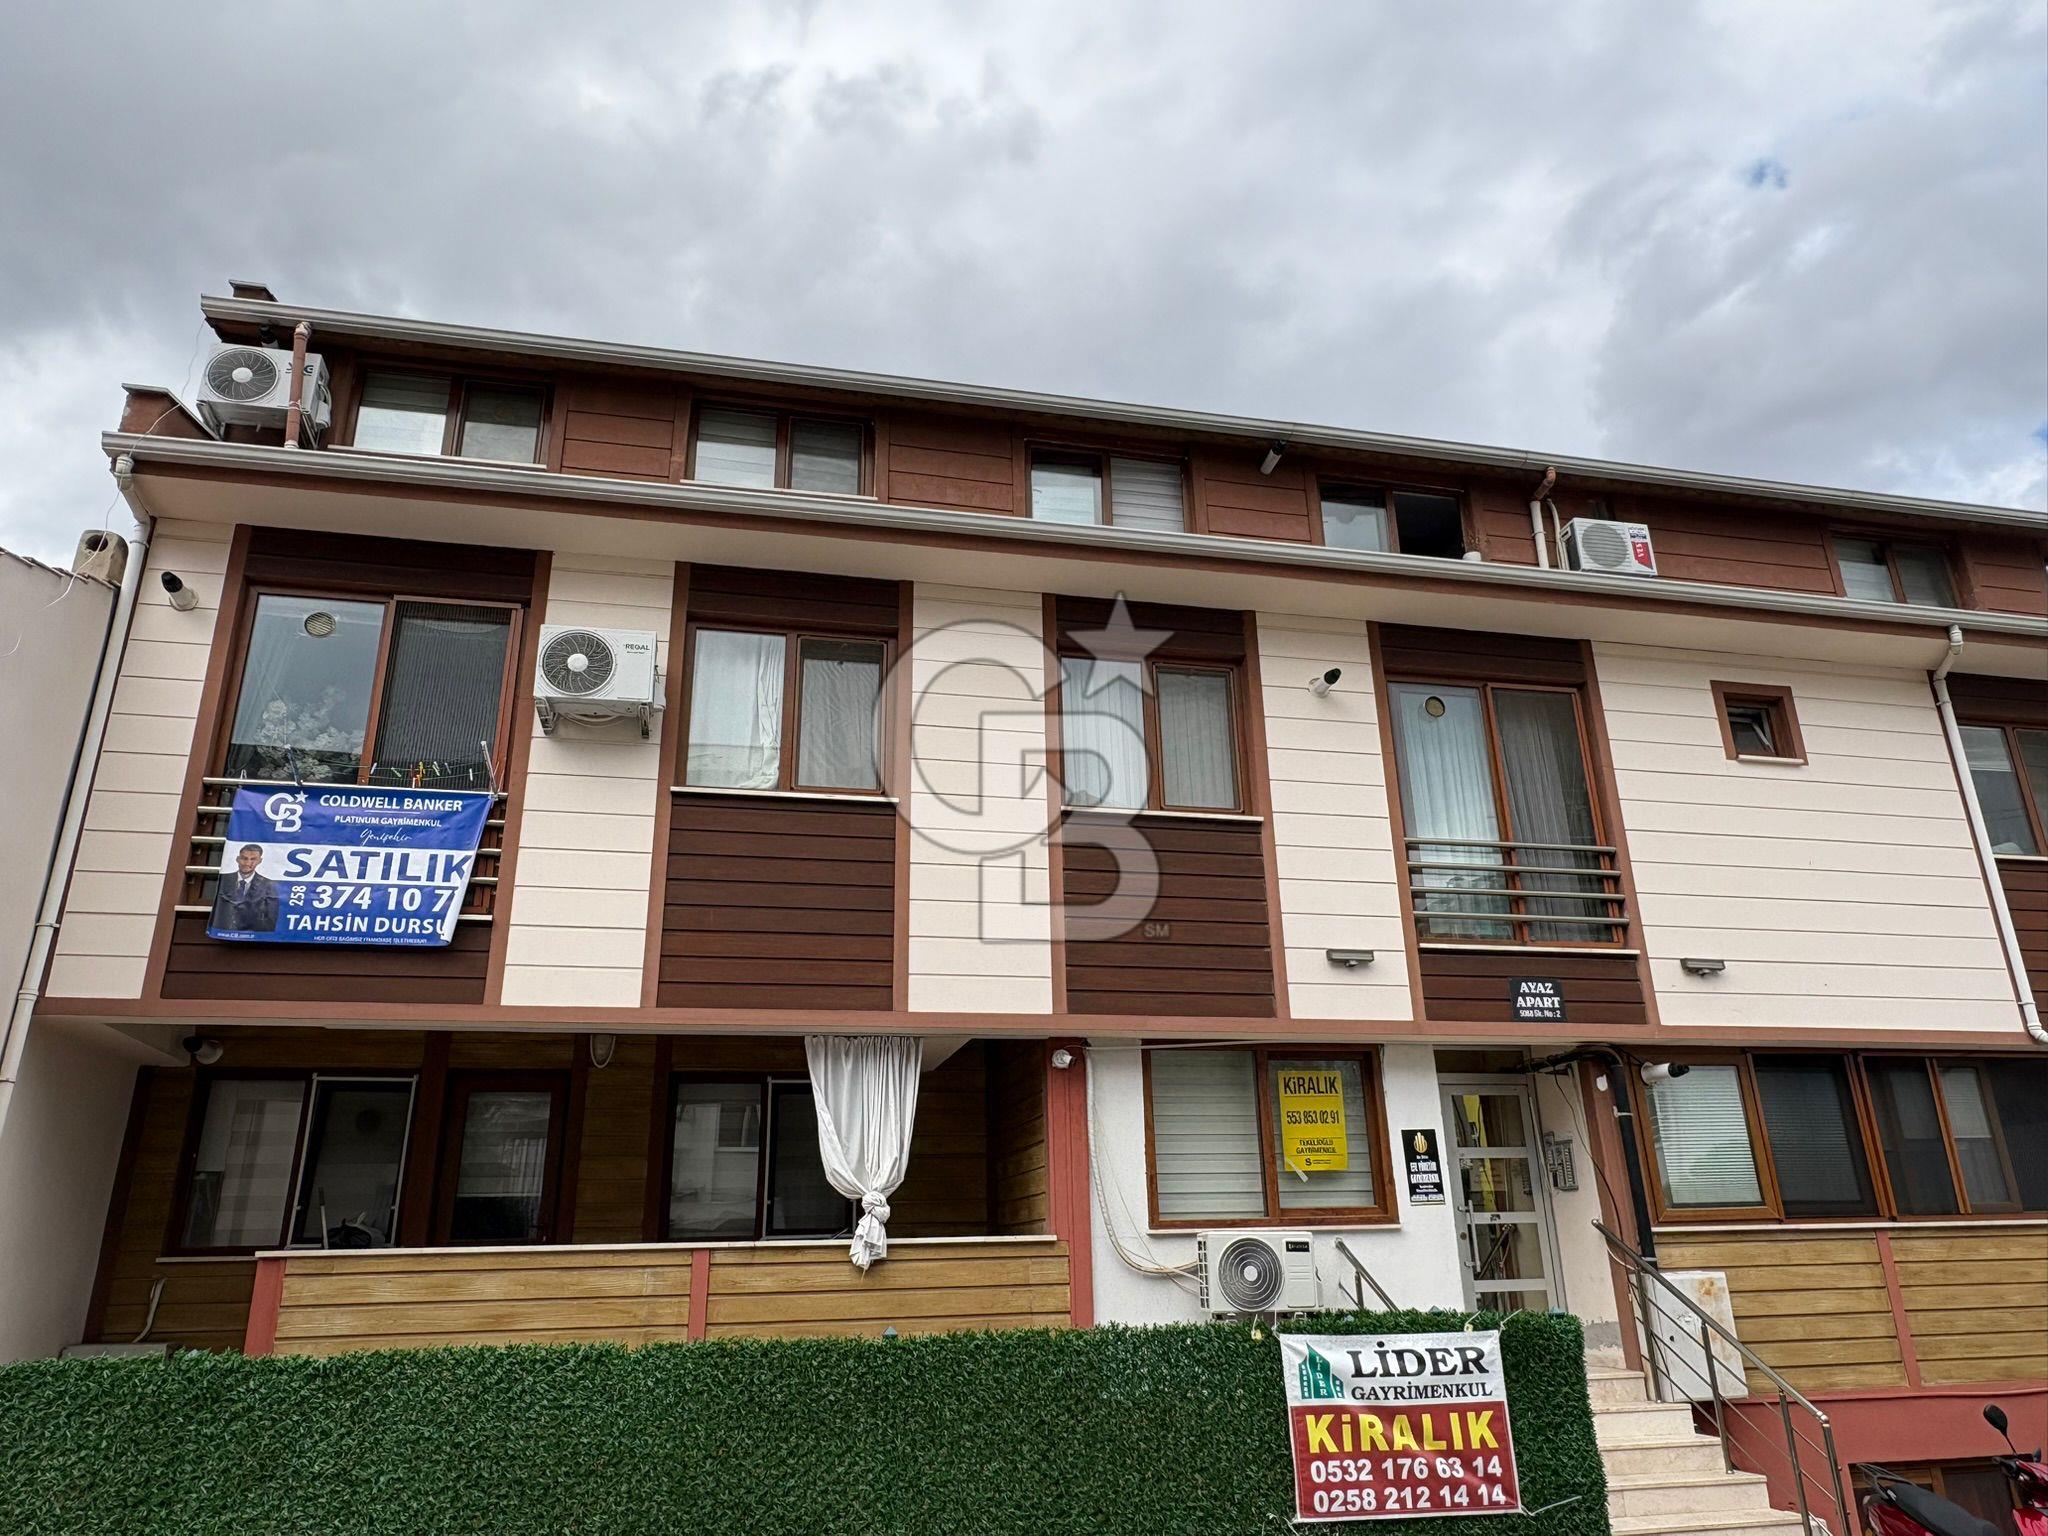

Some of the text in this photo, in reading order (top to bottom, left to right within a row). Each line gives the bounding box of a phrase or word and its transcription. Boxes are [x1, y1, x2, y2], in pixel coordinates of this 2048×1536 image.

[625, 643, 650, 651] REGAL
[320, 794, 463, 812] COLDWELL BANKER
[334, 815, 442, 828] PLATINUM GAYRİMENKUL
[283, 848, 472, 883] SATILIK
[289, 885, 457, 912] 258 374 10 7
[286, 912, 368, 932] TAHSİN
[1520, 982, 1554, 994] AYAZ
[1516, 996, 1560, 1008] APART
[1286, 1110, 1340, 1124] 553 853 02 91
[1347, 1341, 1490, 1379] LİDER
[1351, 1381, 1493, 1401] GAYRİMENKUL
[1310, 1455, 1503, 1483] 0532 176 63 14
[1313, 1484, 1506, 1513] 0258 212 14 14
